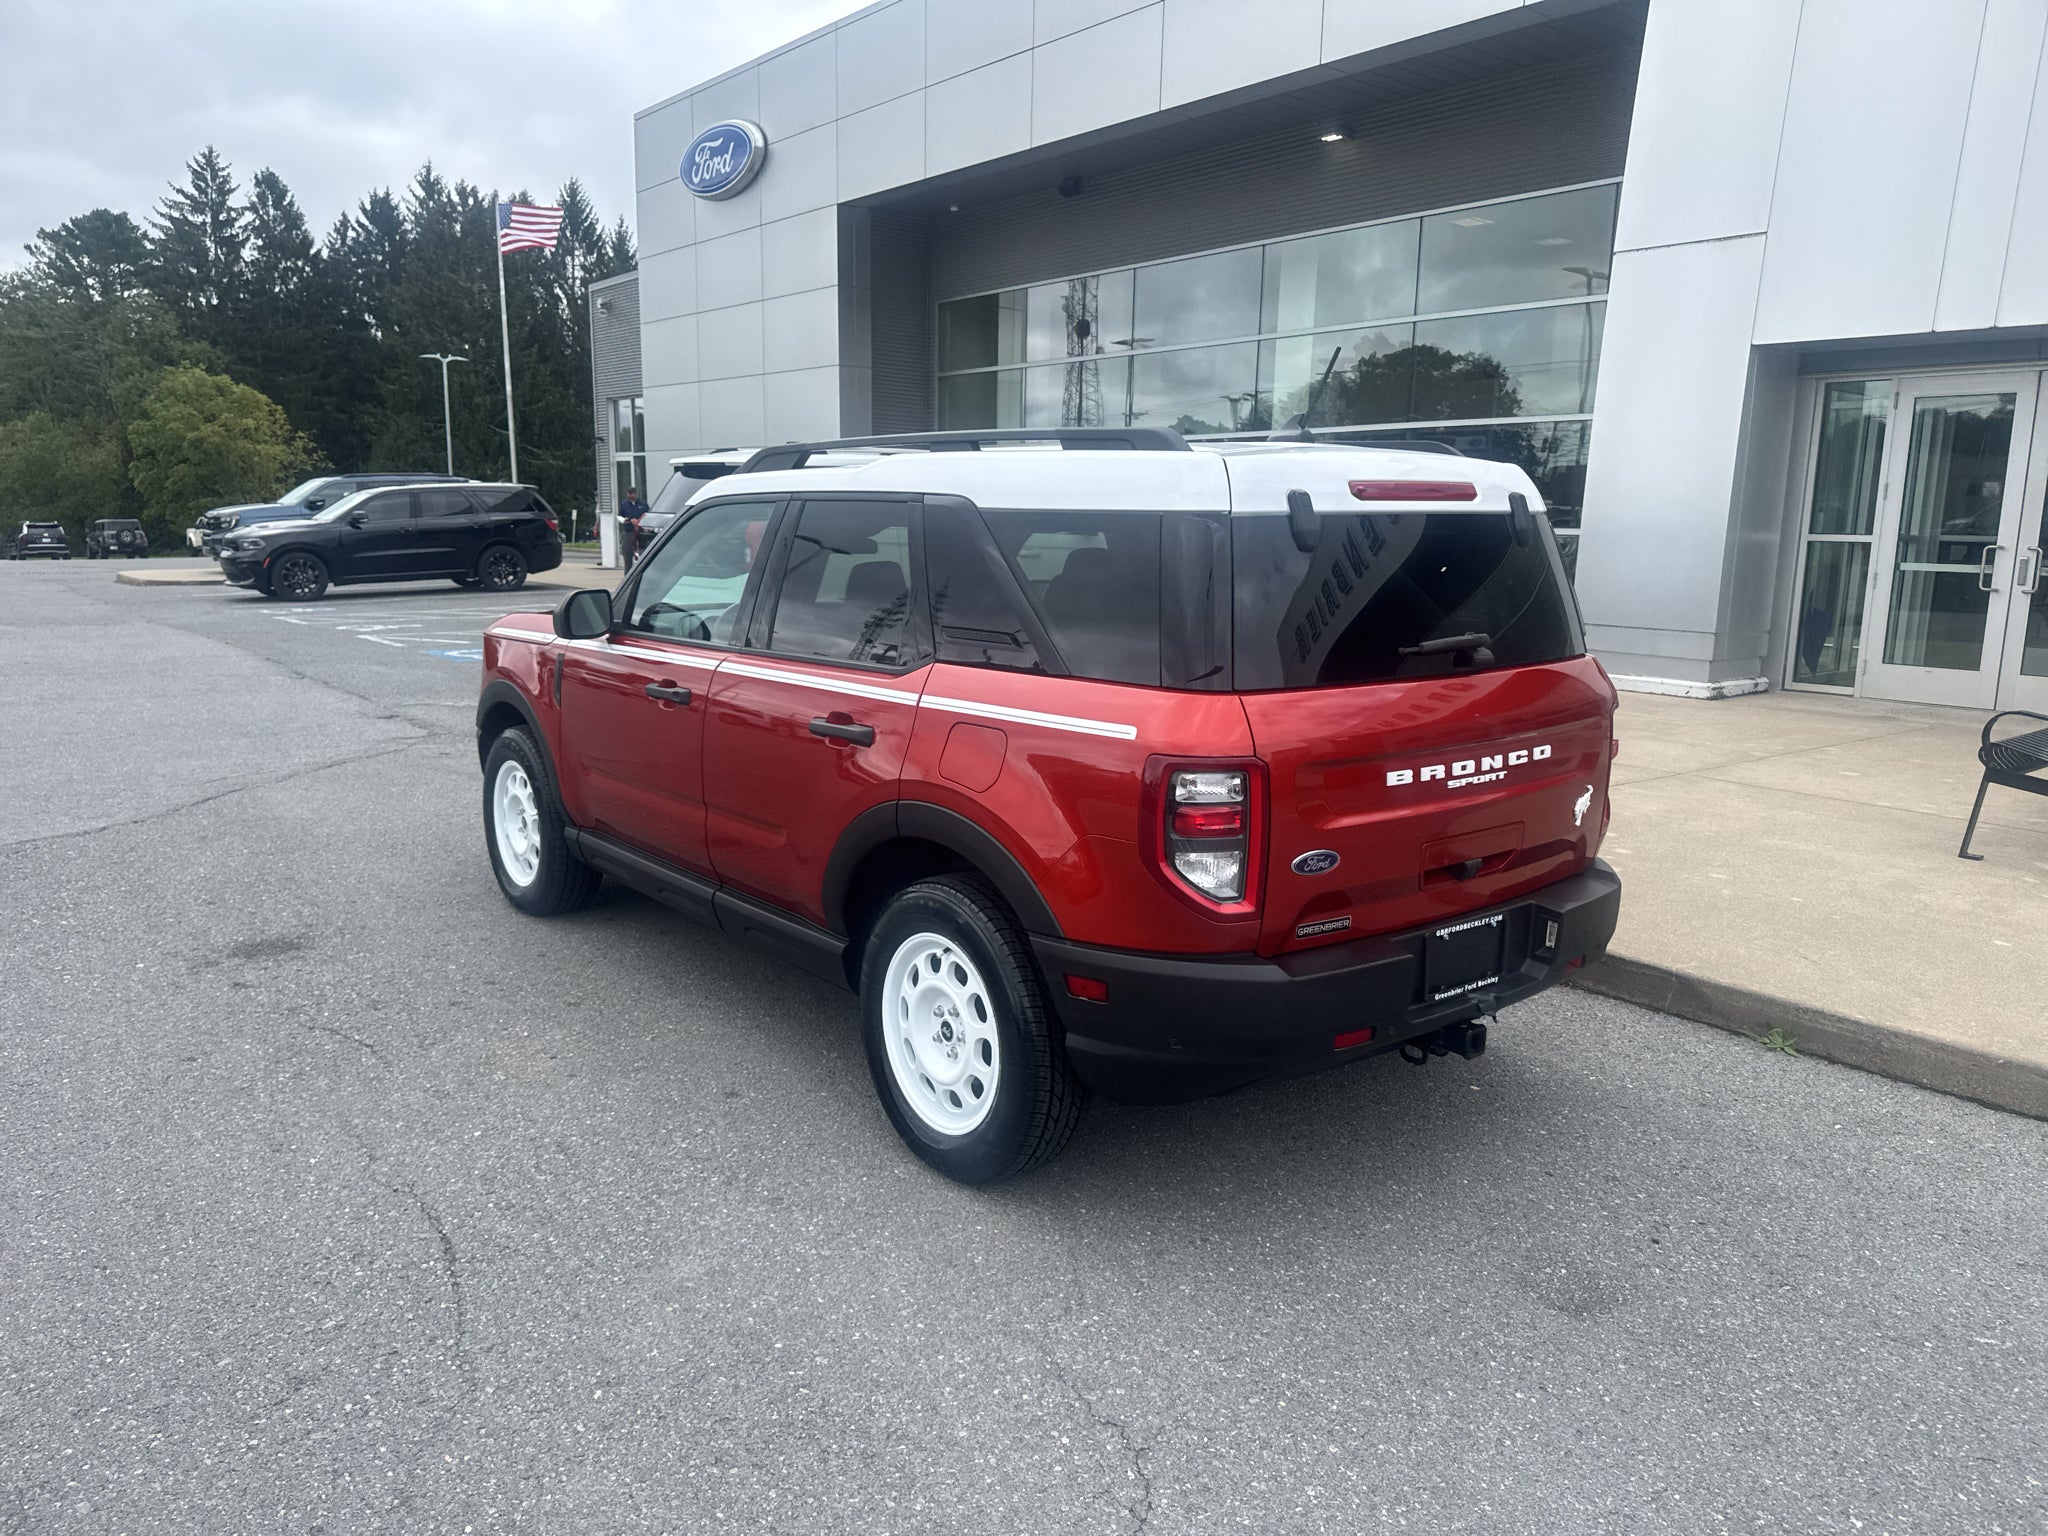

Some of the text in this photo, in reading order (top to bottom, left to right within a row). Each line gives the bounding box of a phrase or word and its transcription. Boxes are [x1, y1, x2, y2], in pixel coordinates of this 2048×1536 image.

[691, 137, 735, 184] Ford
[1386, 744, 1552, 786] BRONCO
[1447, 771, 1507, 788] SPORT
[1304, 855, 1331, 871] Ford
[1297, 919, 1350, 936] GREENBRIER
[1435, 914, 1503, 937] GBRFORDBECKLEY.COM
[1434, 976, 1499, 1001] Greenbrier Ford Beckley
